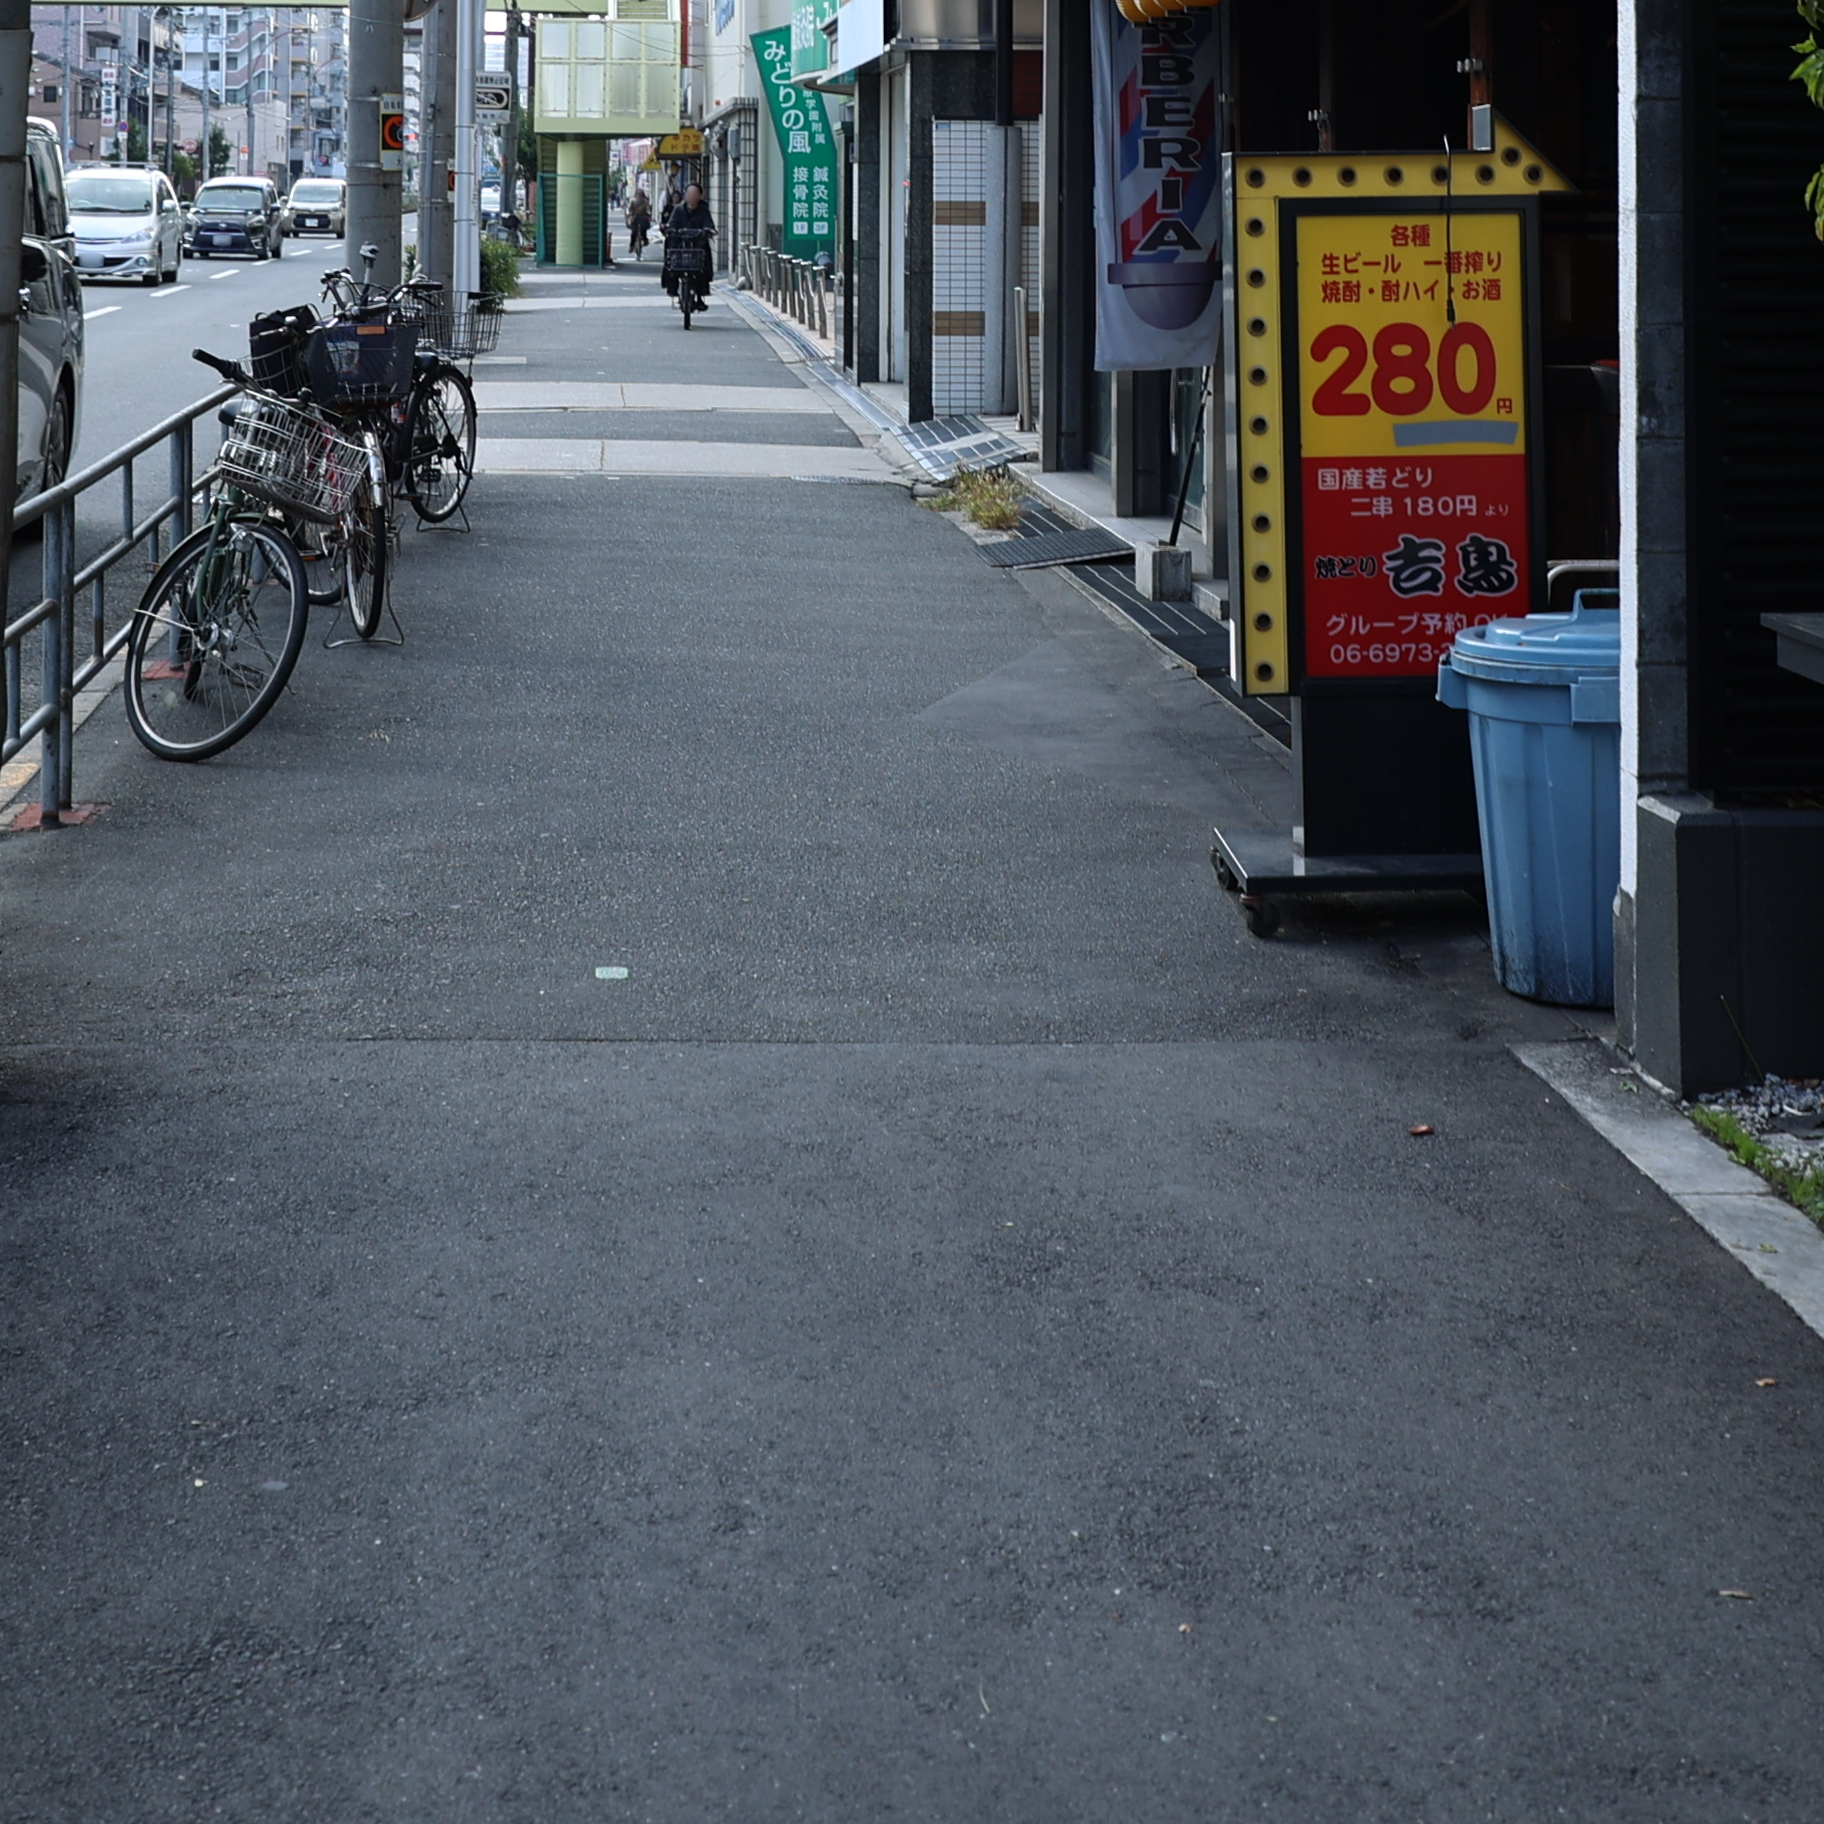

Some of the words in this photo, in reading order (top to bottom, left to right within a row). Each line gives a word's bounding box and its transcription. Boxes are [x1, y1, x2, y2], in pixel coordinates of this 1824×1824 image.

[763, 41, 811, 154] みどりの風
[792, 166, 808, 218] 接骨院
[1390, 223, 1431, 248] 各種
[1321, 252, 1401, 276] 生ビール
[1423, 250, 1504, 275] 一番搾り
[1320, 278, 1502, 304] 焼酎・酎ハイ・お酒
[1317, 467, 1433, 491] 国産若どり
[1350, 495, 1393, 518] 二串
[1403, 494, 1477, 517] 180円
[1484, 504, 1509, 517] より
[1314, 554, 1378, 579] 焼とり
